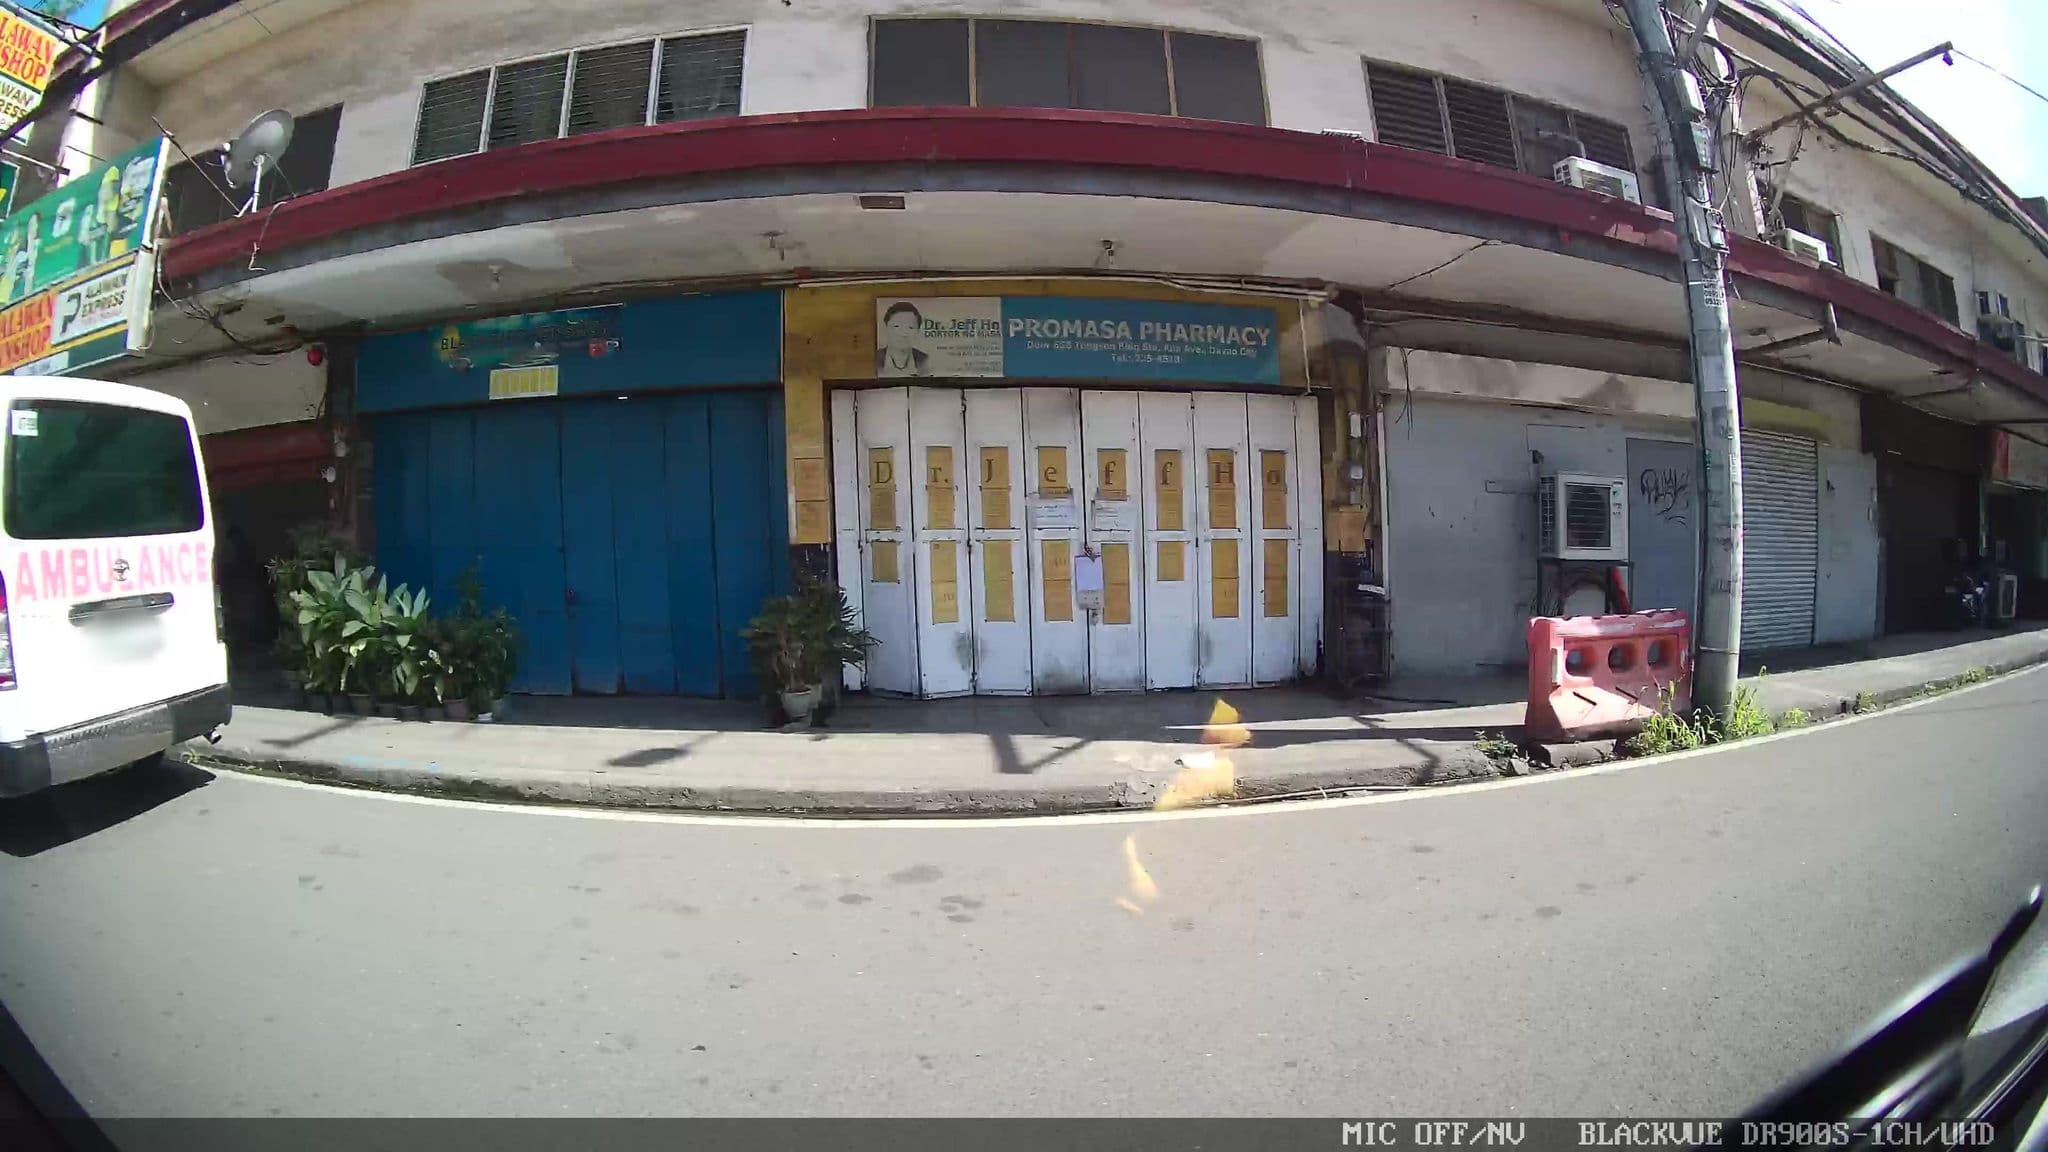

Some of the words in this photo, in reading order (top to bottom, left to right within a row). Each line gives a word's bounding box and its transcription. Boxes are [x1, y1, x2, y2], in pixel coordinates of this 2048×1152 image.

[924, 319, 945, 330] Dr.
[949, 318, 978, 330] Jeff
[1007, 318, 1132, 340] PROMASA
[1139, 321, 1270, 346] PHARMACY
